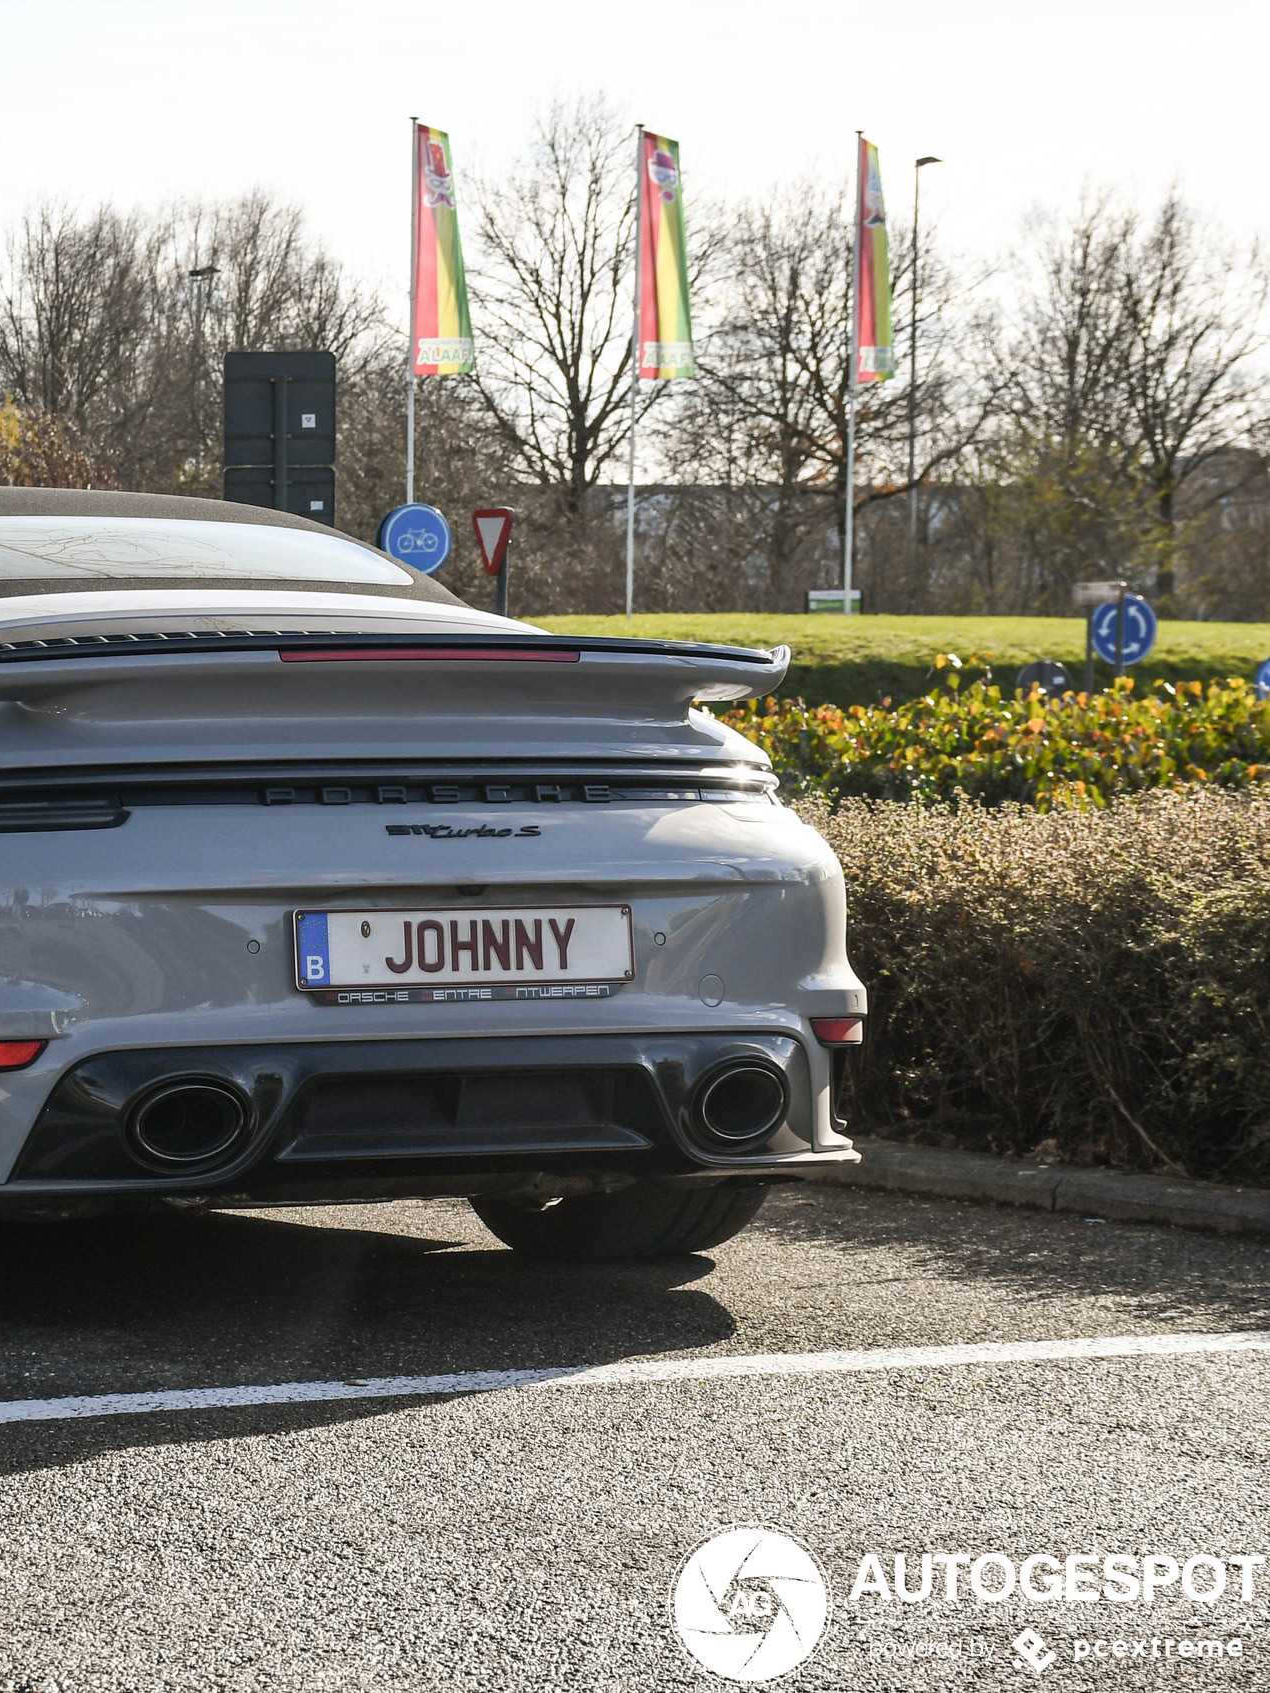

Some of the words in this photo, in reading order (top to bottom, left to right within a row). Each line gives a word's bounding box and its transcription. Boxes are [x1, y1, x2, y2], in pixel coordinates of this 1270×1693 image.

[261, 784, 612, 806] PORSCHE
[385, 918, 576, 974] JOHNNY
[306, 955, 325, 980] B
[326, 991, 409, 1003] PORSCHE
[422, 988, 492, 1000] CENTRE
[505, 985, 610, 998] ANTWERPEN
